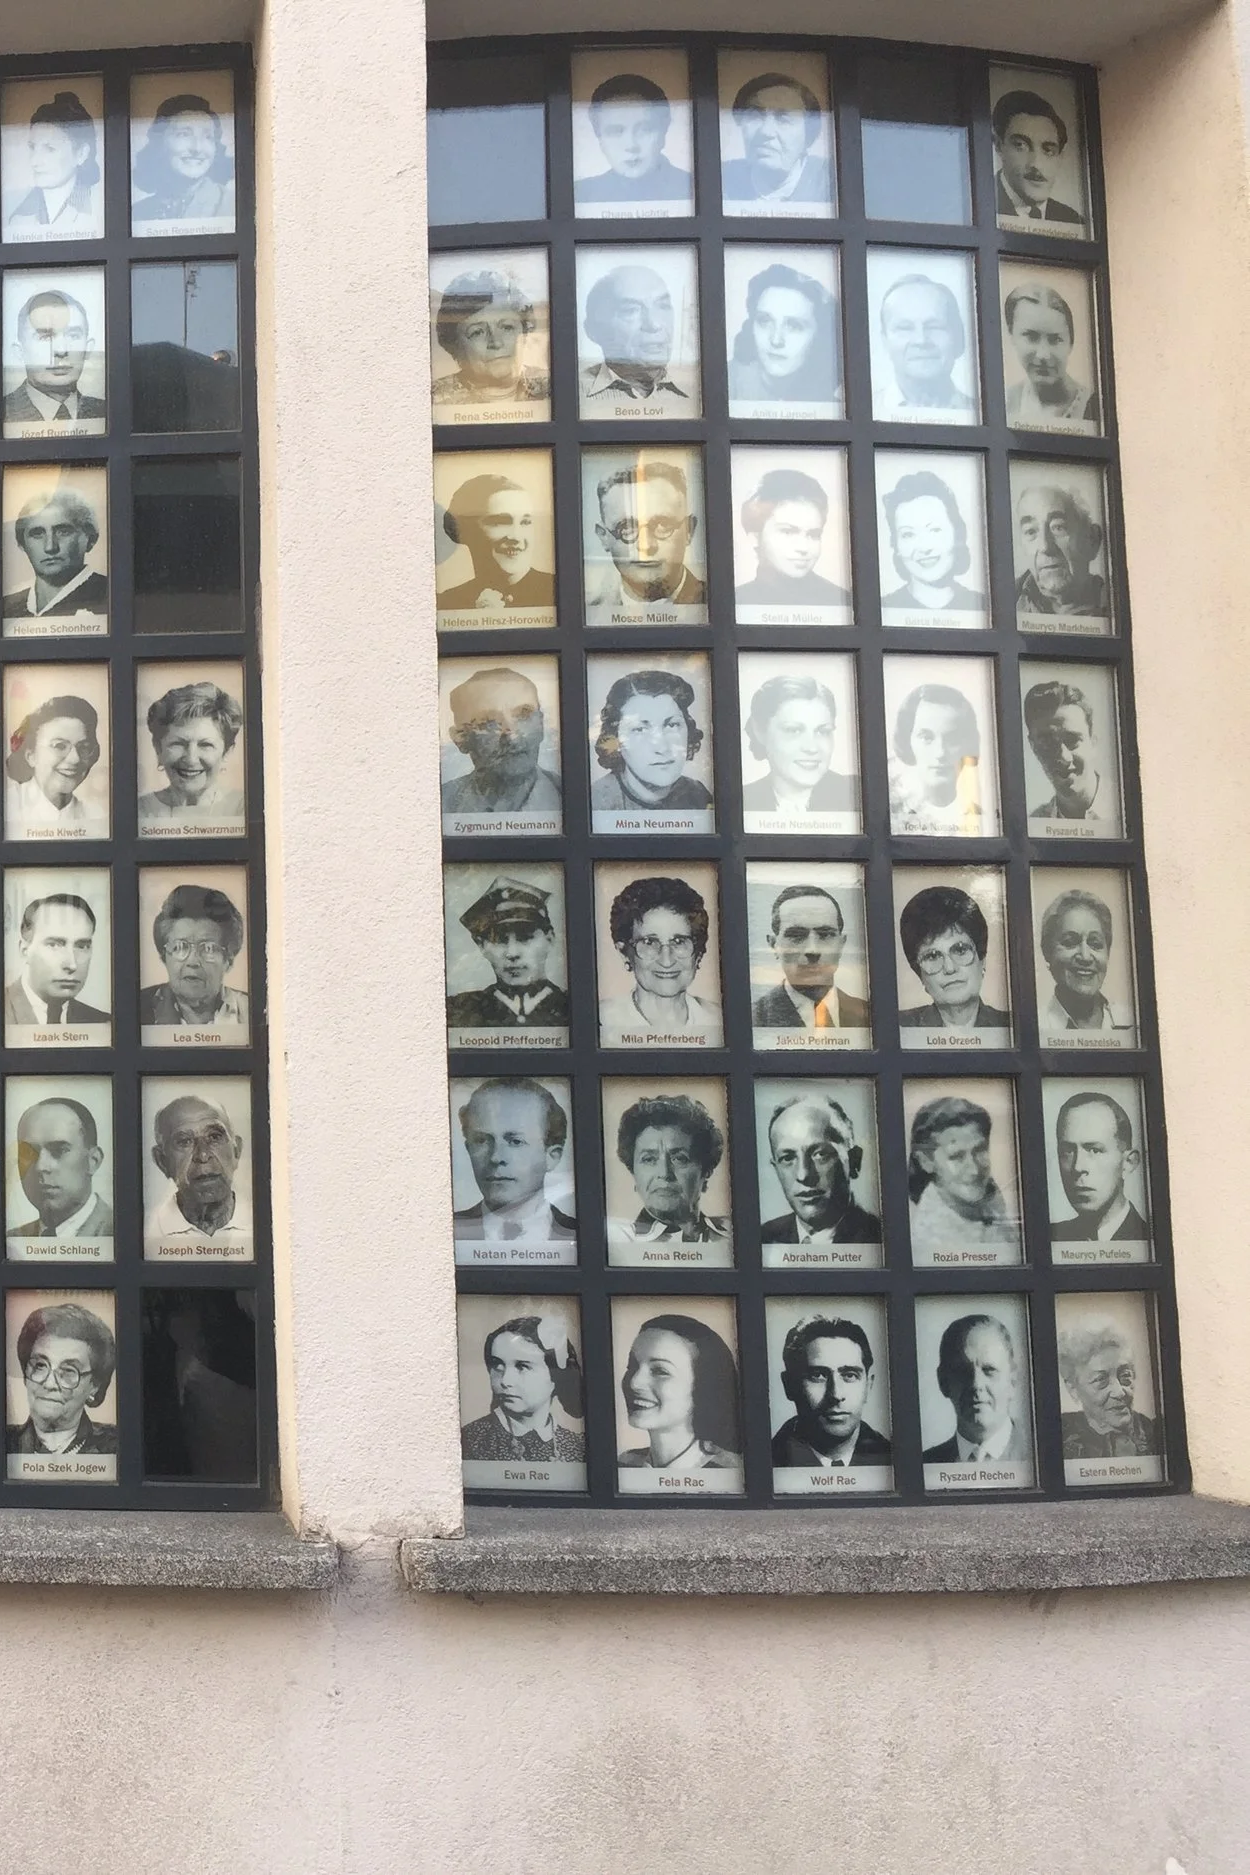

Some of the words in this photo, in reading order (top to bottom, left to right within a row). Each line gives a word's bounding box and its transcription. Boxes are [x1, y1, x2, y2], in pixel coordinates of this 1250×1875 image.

[453, 411, 479, 422] Rena
[614, 406, 641, 417] Beno
[443, 616, 479, 627] Helena
[481, 614, 554, 627] Hirsz-Horowitz
[611, 613, 643, 624] Mosze
[645, 612, 678, 623] Müller
[13, 625, 47, 636] Helena
[453, 820, 502, 833] Zygmund
[505, 819, 556, 830] Neumann
[615, 818, 641, 830] Mina
[643, 818, 694, 829] Neumann
[26, 828, 55, 838] Frieda
[56, 827, 87, 837] Kiwetz
[141, 826, 181, 837] Salomea
[1045, 825, 1078, 838] Ryszard
[33, 1033, 61, 1043] Izaak
[62, 1032, 89, 1042] Stern
[173, 1033, 190, 1043] Lea
[194, 1033, 222, 1043] Stern
[458, 1035, 500, 1047] Leopold
[502, 1034, 562, 1047] Pfefferberg
[621, 1033, 644, 1044] Mila
[646, 1033, 706, 1046] Pfefferberg
[775, 1035, 806, 1047] Jakub
[808, 1035, 851, 1046] Perlman
[926, 1035, 947, 1046] Lola
[949, 1035, 982, 1046] Orzech
[1047, 1036, 1075, 1048] Estera
[26, 1245, 57, 1256] Dawid
[59, 1245, 101, 1257] Schlang
[157, 1245, 193, 1258] Joseph
[195, 1245, 245, 1258] Sterngast
[472, 1249, 507, 1259] Natan
[642, 1250, 671, 1261] Anna
[673, 1250, 703, 1261] Reich
[933, 1252, 959, 1262] Rozia
[962, 1251, 997, 1262] Presser
[1061, 1249, 1098, 1262] Maurycy
[782, 1252, 829, 1263] Abraham
[832, 1252, 862, 1262] Putter
[22, 1462, 45, 1472] Pola
[47, 1462, 72, 1472] Szek
[74, 1462, 107, 1475] Jogew
[1079, 1467, 1108, 1478] Estera
[1109, 1465, 1142, 1477] Rechen
[504, 1470, 527, 1480] Ewa
[529, 1470, 550, 1480] Rac
[810, 1475, 834, 1485] Wolf
[837, 1475, 856, 1485] Rac
[939, 1471, 976, 1485] Ryszard
[979, 1470, 1015, 1481] Rechen
[658, 1476, 682, 1487] Fela
[684, 1477, 705, 1487] Rac
